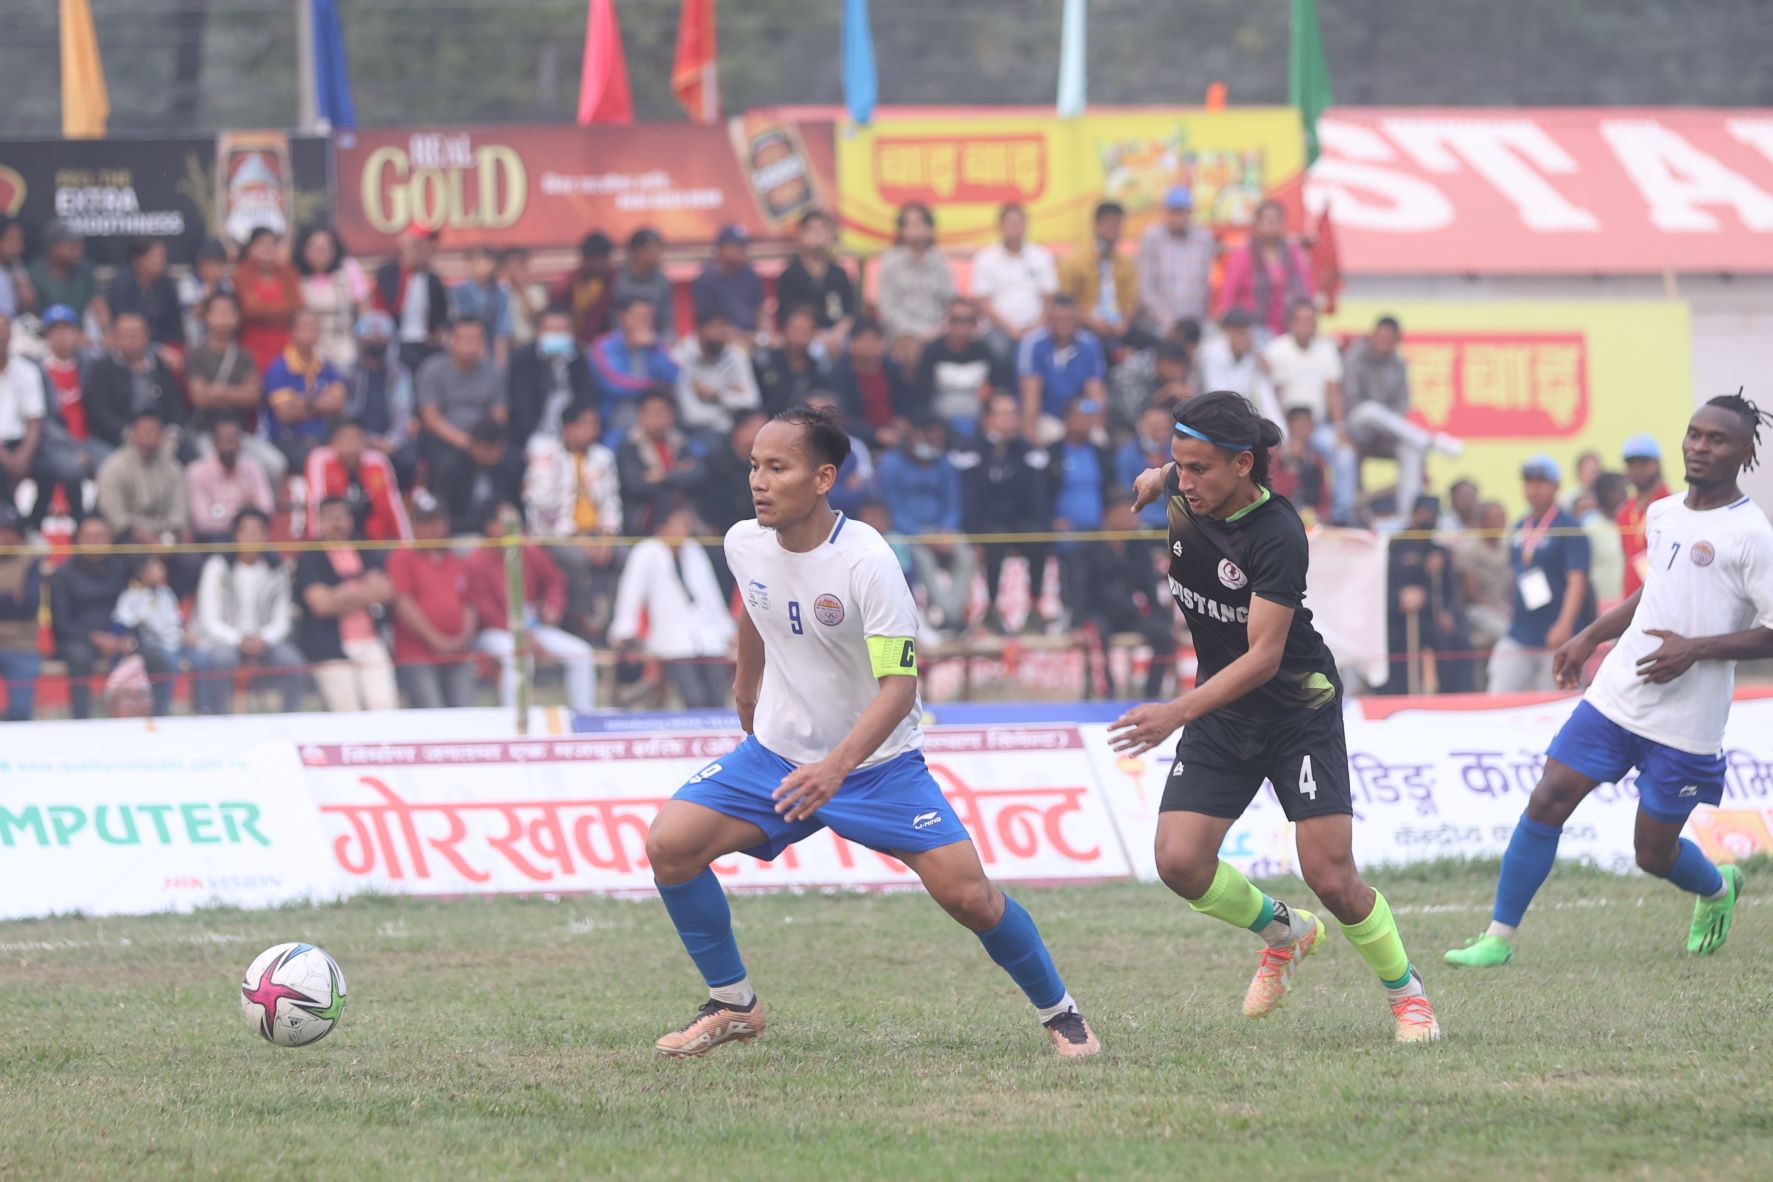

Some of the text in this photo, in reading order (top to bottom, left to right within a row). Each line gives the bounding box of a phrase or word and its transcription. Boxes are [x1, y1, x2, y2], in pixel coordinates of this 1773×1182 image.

[361, 144, 528, 234] GOLD
[1667, 541, 1681, 572] 7
[788, 600, 804, 635] 9
[899, 640, 915, 668] C
[1298, 754, 1318, 801] 4
